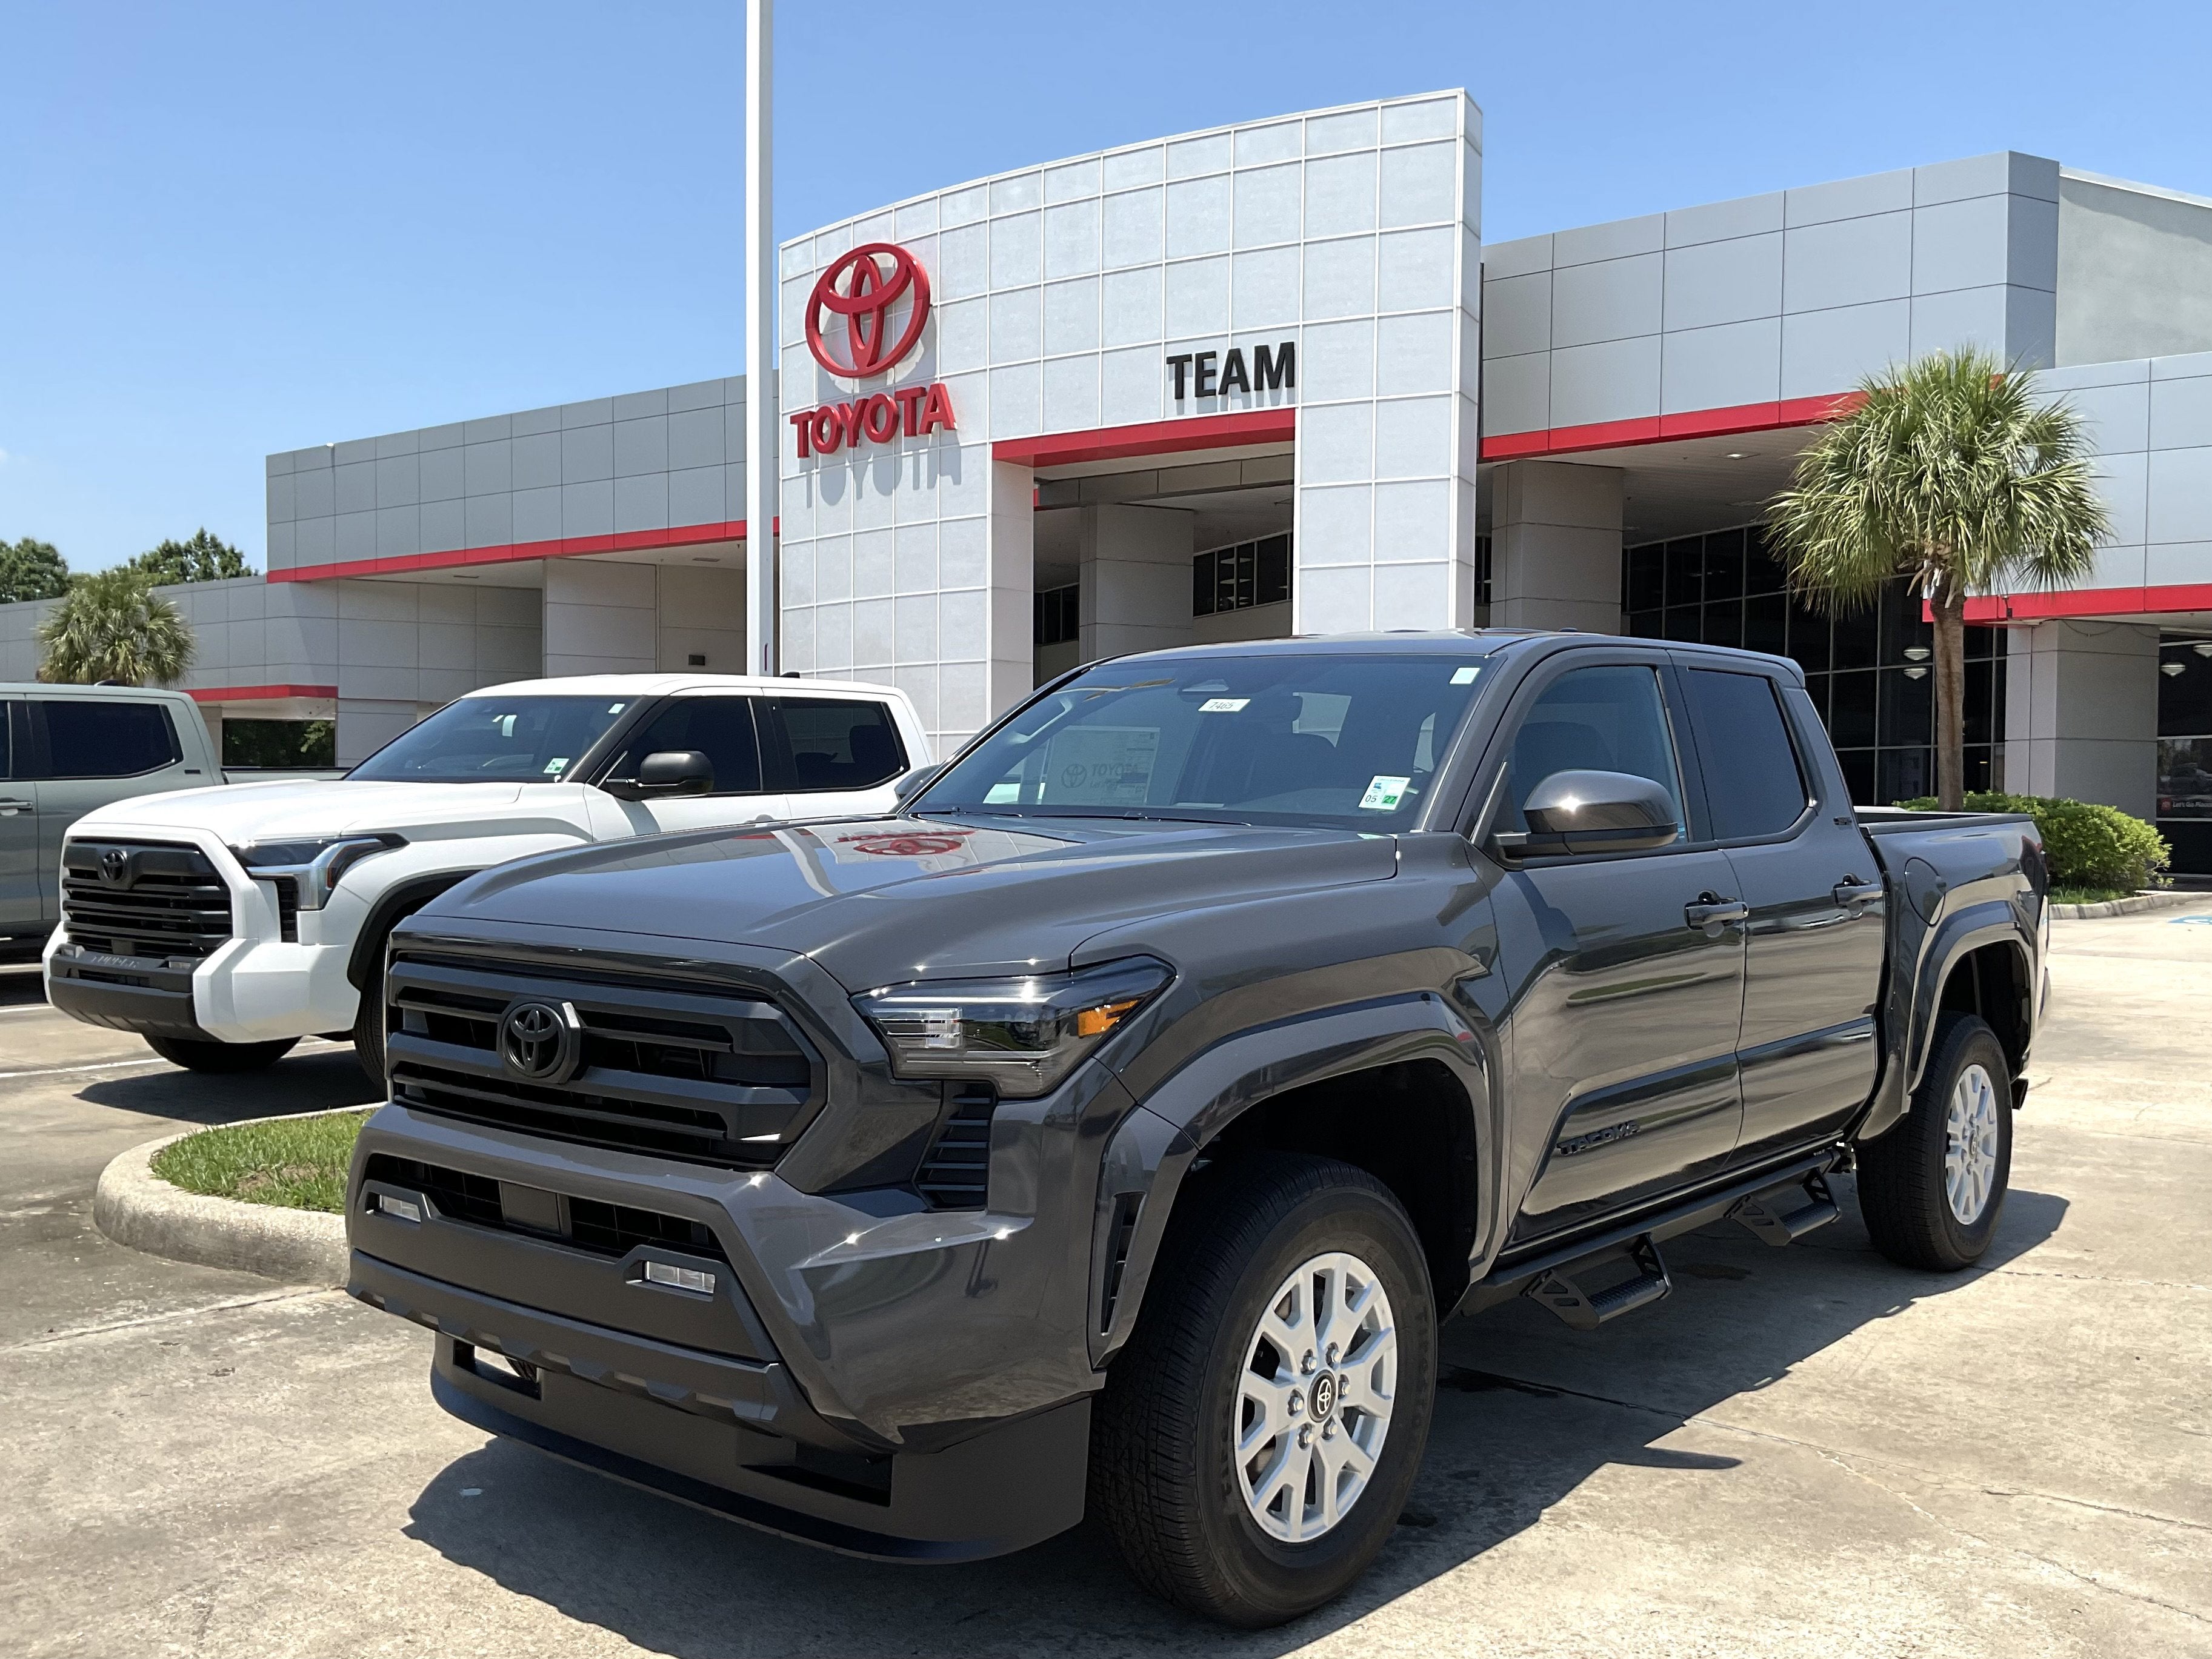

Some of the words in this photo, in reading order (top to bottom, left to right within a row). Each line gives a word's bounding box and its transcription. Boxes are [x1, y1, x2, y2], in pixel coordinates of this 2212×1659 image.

[1167, 342, 1294, 400] TEAM
[790, 383, 956, 458] TOYOTA
[1365, 794, 1378, 803] 05
[1384, 796, 1397, 804] 27
[1557, 1120, 1640, 1155] TACOMA
